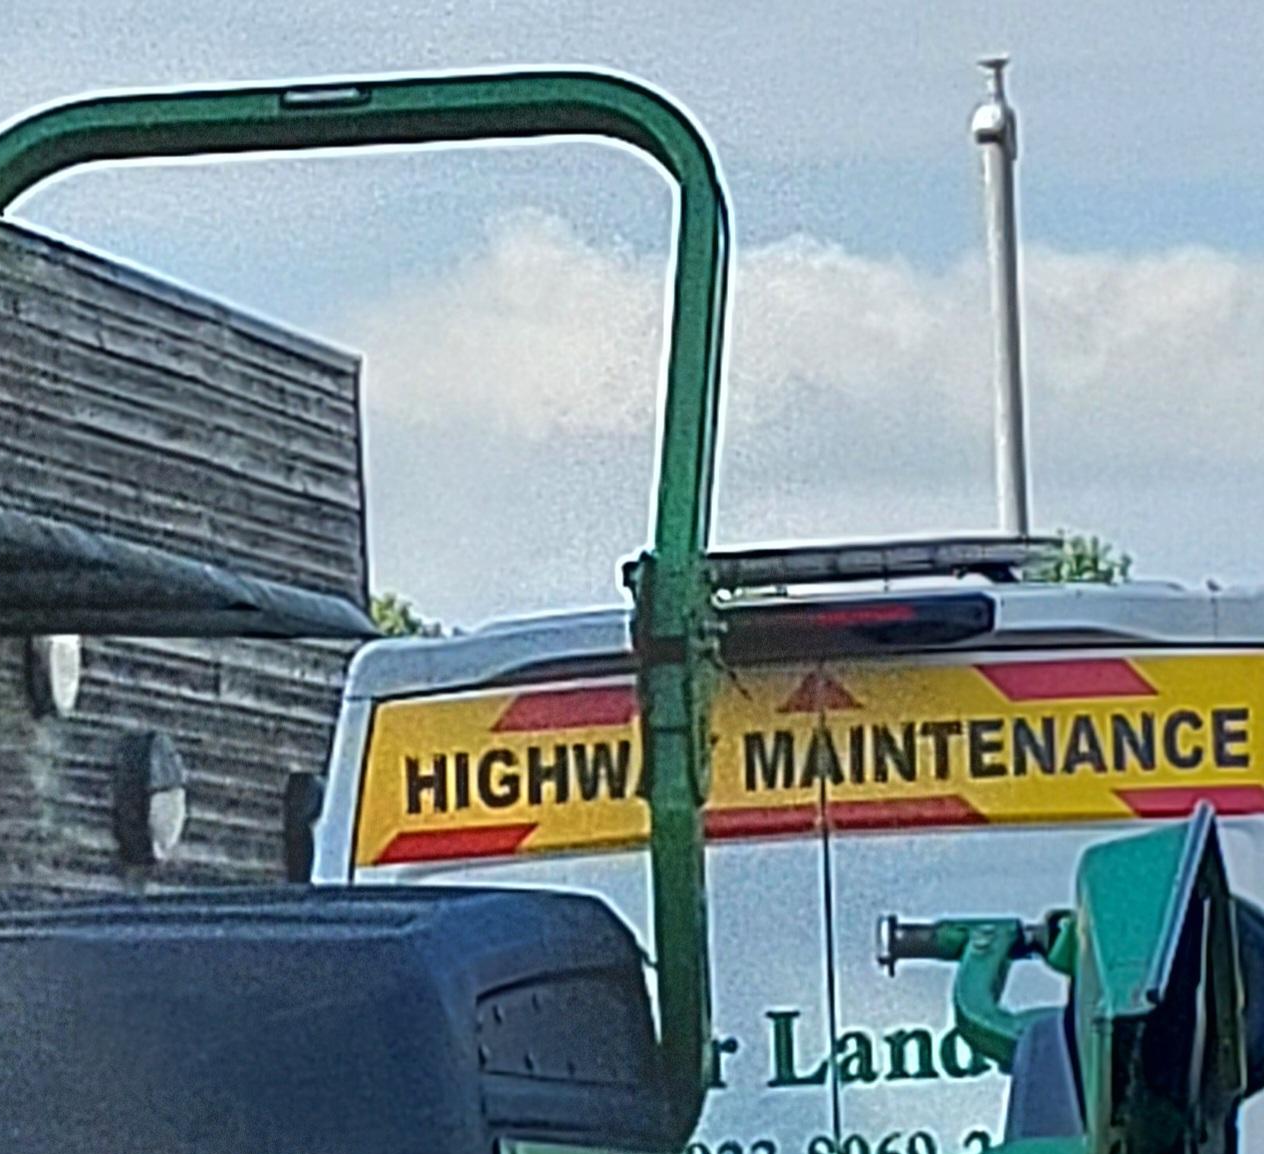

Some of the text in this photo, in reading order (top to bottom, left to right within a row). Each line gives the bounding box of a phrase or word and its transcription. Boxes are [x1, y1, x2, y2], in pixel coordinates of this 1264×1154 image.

[405, 708, 1251, 815] HIGHW MAINTENANCE
[764, 1010, 993, 1088] Land
